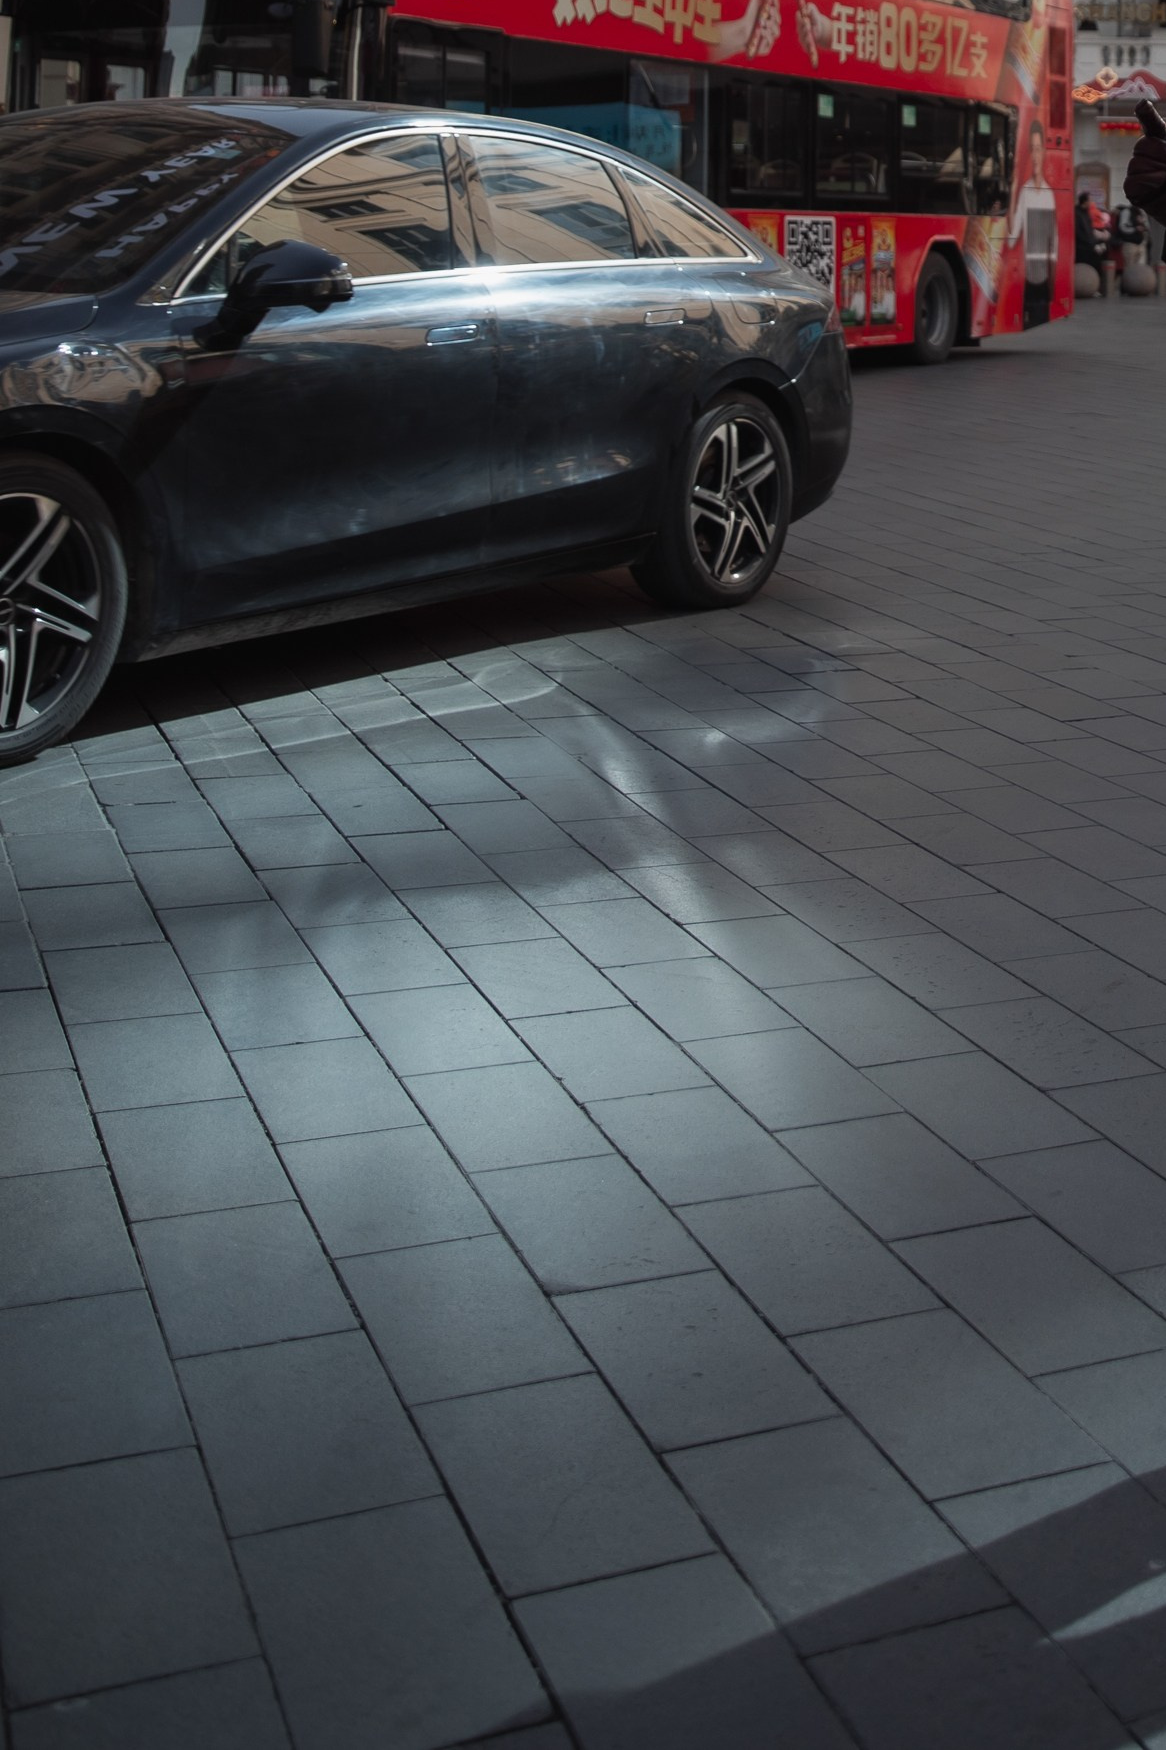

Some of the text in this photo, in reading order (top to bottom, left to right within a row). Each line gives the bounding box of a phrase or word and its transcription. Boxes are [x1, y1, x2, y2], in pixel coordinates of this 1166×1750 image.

[830, 2, 988, 79] 年销80多亿支
